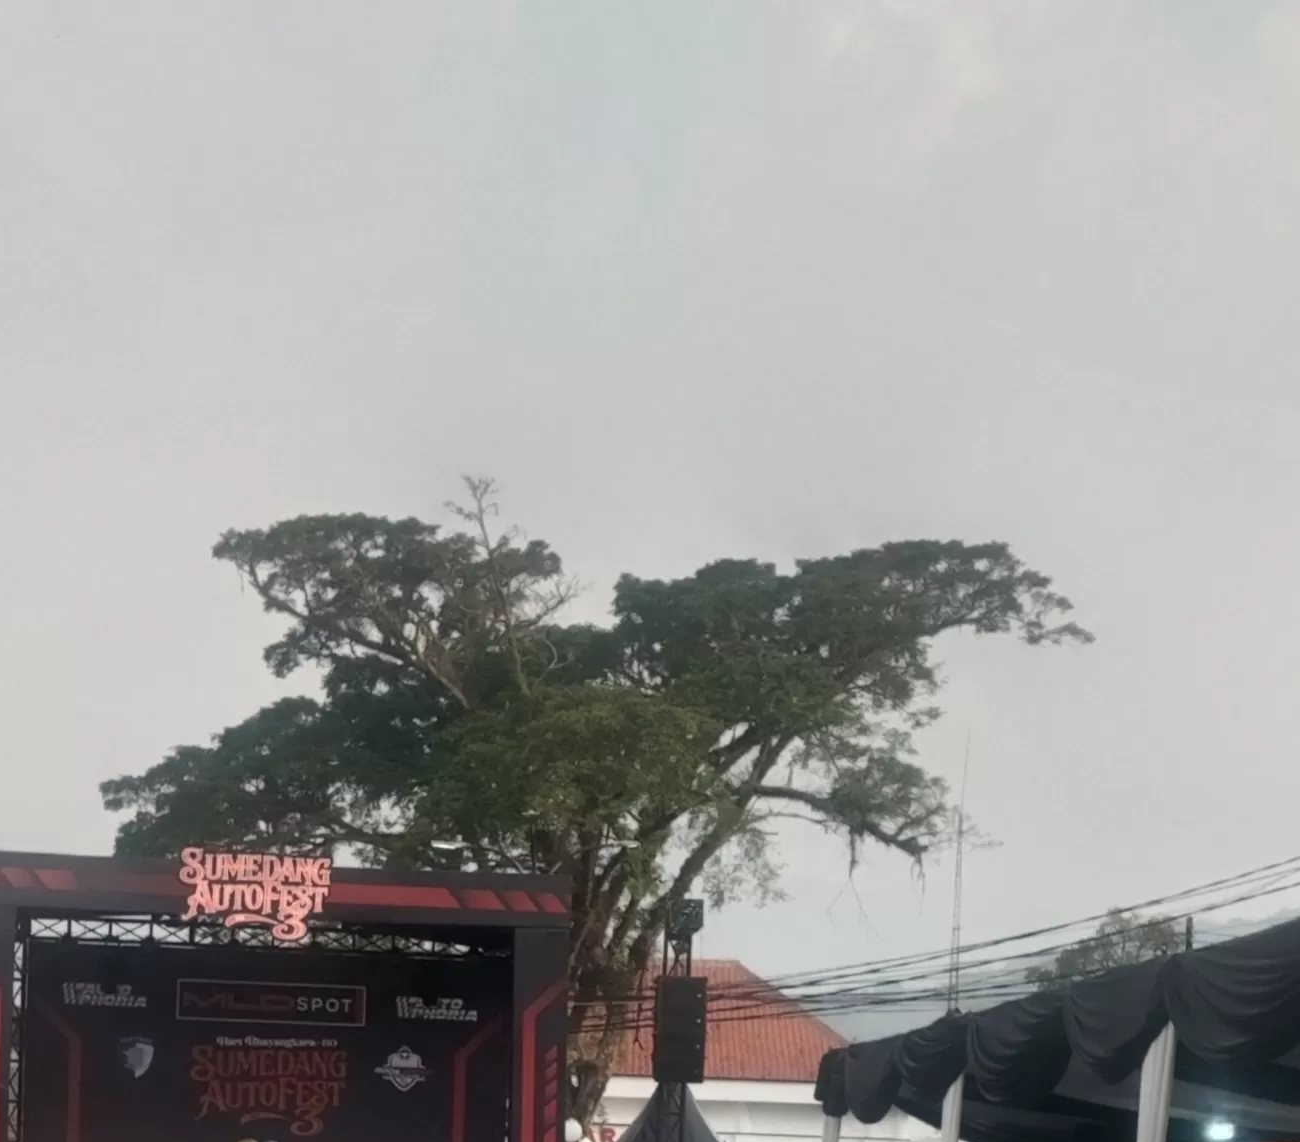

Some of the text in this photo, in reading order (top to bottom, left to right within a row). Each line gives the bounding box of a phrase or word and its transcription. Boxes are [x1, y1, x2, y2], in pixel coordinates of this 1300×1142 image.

[180, 847, 332, 886] SUMEDANG
[272, 909, 307, 940] 3
[190, 1045, 348, 1081] SUMEDANG
